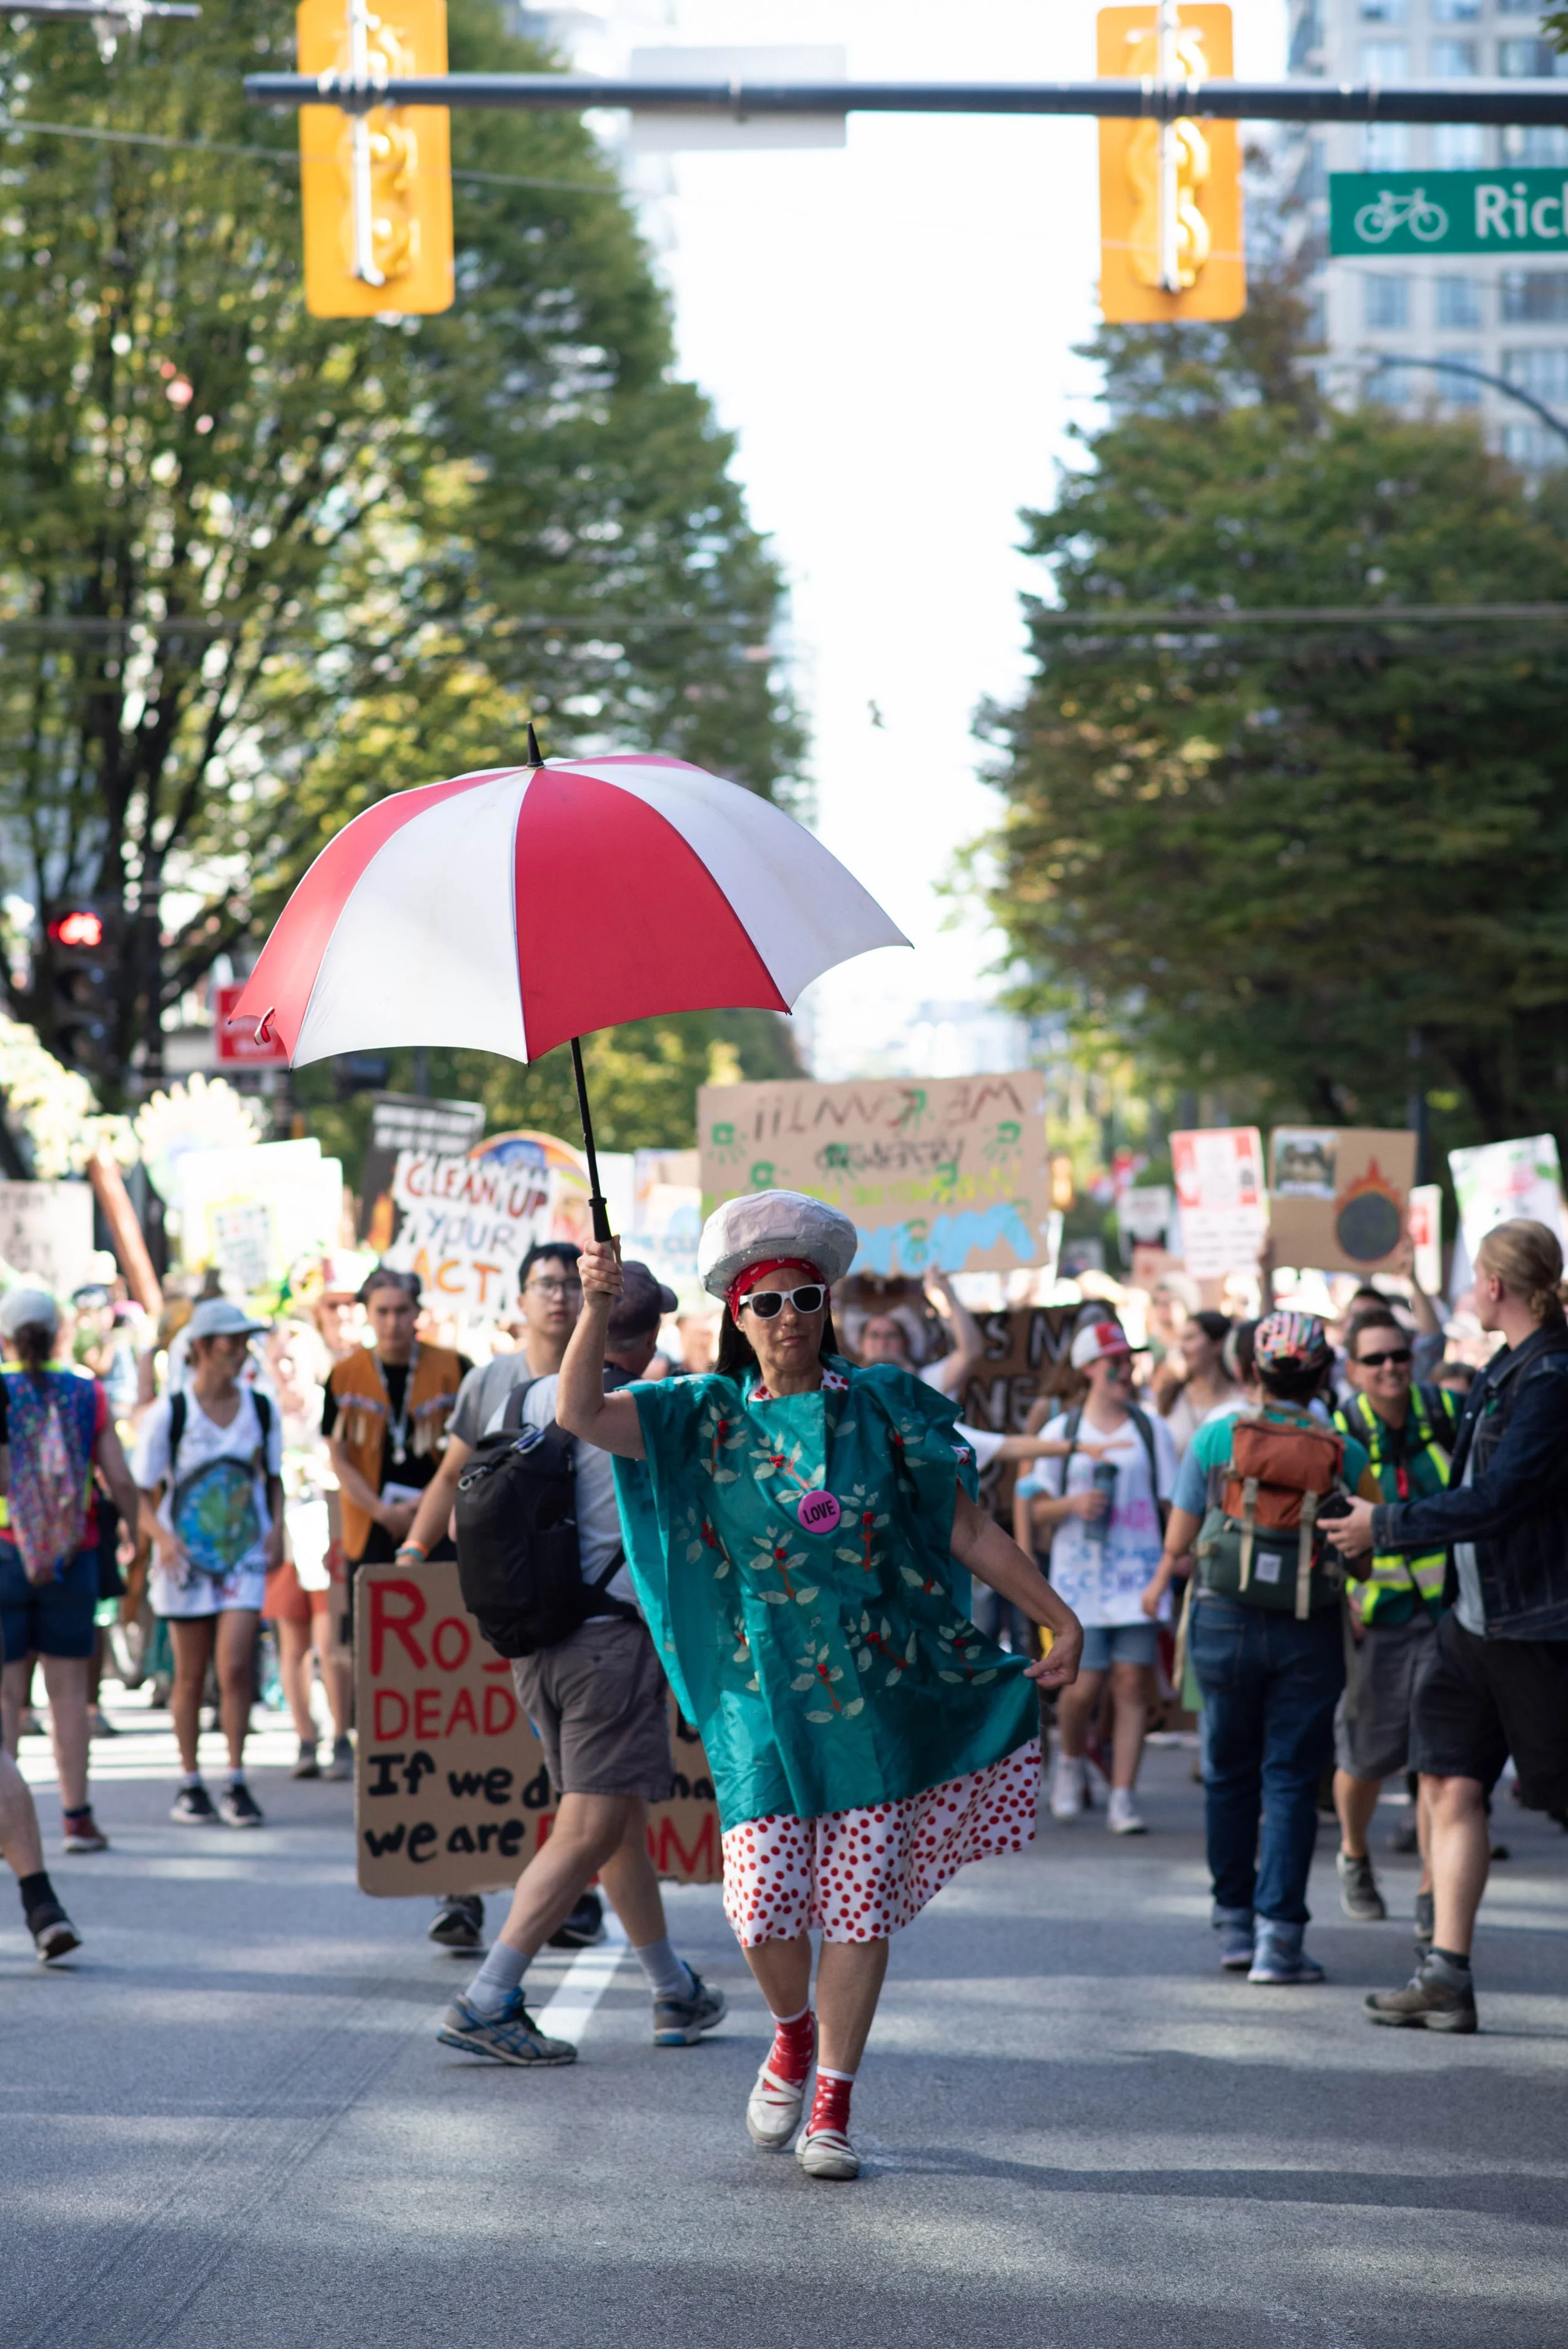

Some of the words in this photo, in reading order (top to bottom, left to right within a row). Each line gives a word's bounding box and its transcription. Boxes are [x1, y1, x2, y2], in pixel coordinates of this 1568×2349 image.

[405, 1162, 496, 1204] CLEAN
[507, 1185, 548, 1218] UP
[427, 1207, 519, 1257] YOUR
[413, 1247, 502, 1303] ACT
[803, 1500, 836, 1524] LOVE
[373, 1685, 517, 1742] DEAD
[367, 1751, 435, 1796] If
[447, 1768, 513, 1805] we
[364, 1821, 438, 1864] we
[447, 1819, 526, 1857] are
